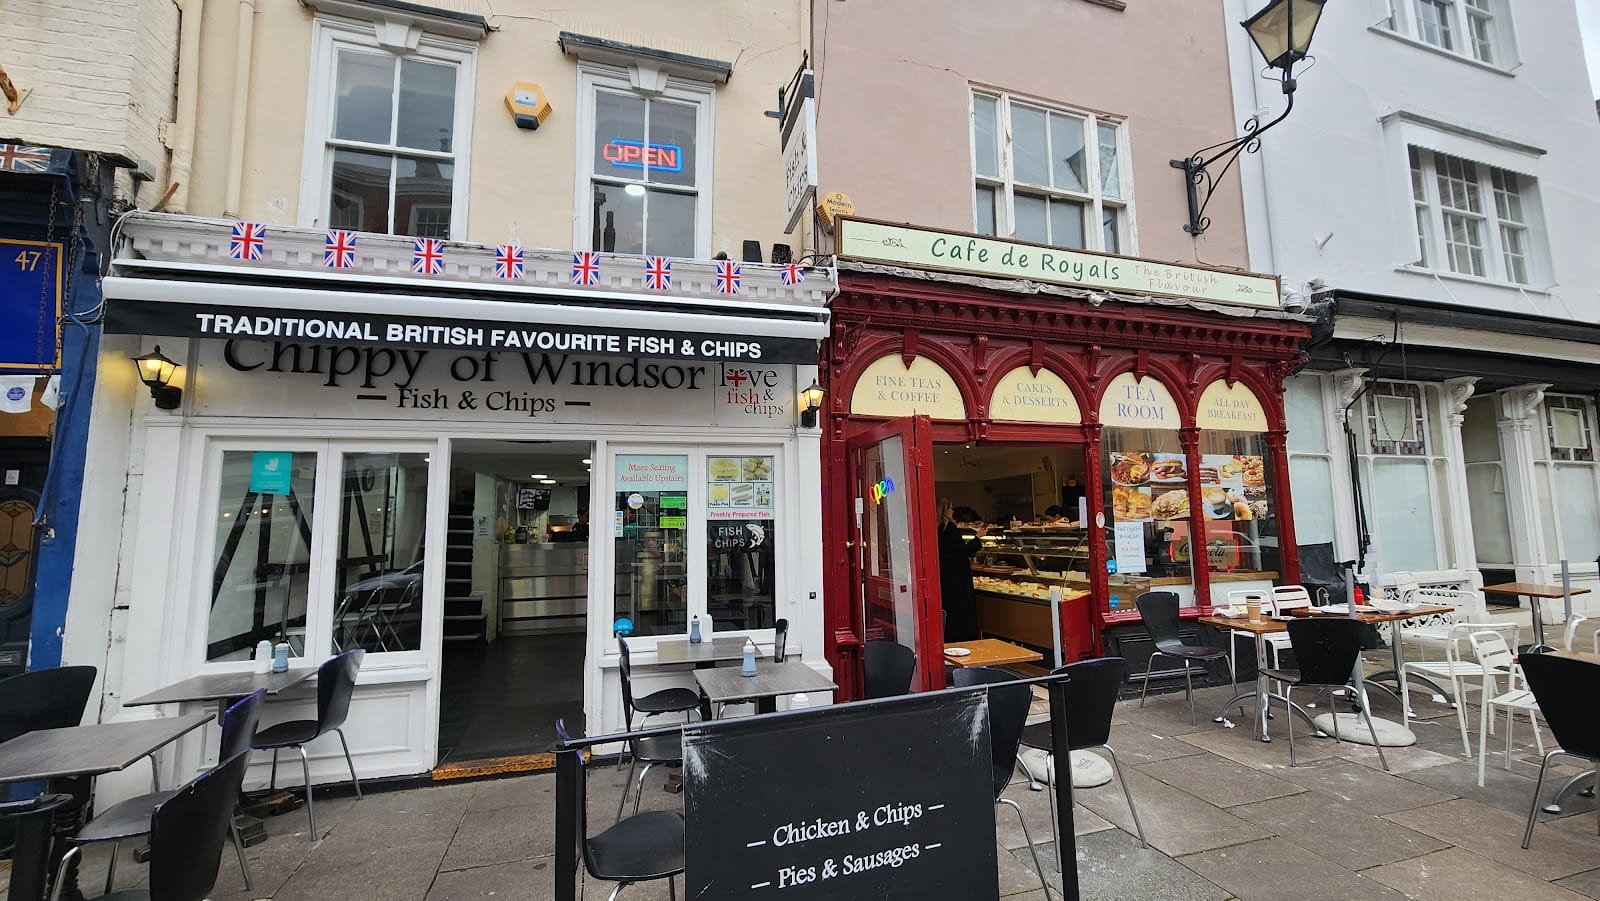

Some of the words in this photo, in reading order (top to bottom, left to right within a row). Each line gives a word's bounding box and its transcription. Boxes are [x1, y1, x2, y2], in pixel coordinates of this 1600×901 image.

[603, 142, 677, 168] OPEN
[826, 198, 852, 209] Modern
[15, 251, 43, 271] 47
[930, 238, 989, 262] Cafe
[1001, 246, 1030, 267] de
[1041, 253, 1120, 282] Royals
[1134, 264, 1162, 277] The
[1164, 269, 1220, 285] British
[1148, 278, 1208, 294] Flavour
[196, 313, 379, 341] TRADITIONAL
[386, 324, 483, 346] BRITISH
[490, 329, 620, 353] FAVOURITE
[627, 335, 674, 354] FISH
[680, 339, 696, 356] &
[700, 340, 762, 359] CHIPS
[223, 338, 429, 388] Chippy
[450, 350, 501, 382] of
[521, 351, 706, 390] Windsor
[875, 375, 906, 387] FINE
[908, 376, 942, 389] TEAS
[1016, 382, 1053, 394] CAKES
[727, 387, 759, 405] fish
[763, 388, 774, 401] &
[878, 390, 887, 401] &
[890, 390, 941, 403] COFFEE
[1002, 396, 1010, 405] &
[1013, 395, 1069, 408] DESSERTS
[1122, 384, 1157, 402] TEA
[396, 387, 449, 410] Fish
[457, 390, 478, 410] &
[485, 390, 556, 418] Chips
[744, 400, 785, 418] chips
[1214, 398, 1230, 408] ALL
[1233, 400, 1251, 410] DAY
[1116, 403, 1165, 421] ROOM
[1207, 409, 1258, 422] BREAKFAST
[628, 463, 649, 471] More
[650, 463, 677, 473] Seating
[620, 474, 653, 482] Available
[655, 474, 684, 484] Upstairs
[710, 511, 731, 519] Freshly
[732, 511, 758, 519] Prepared
[718, 526, 743, 537] FISH
[714, 539, 746, 550] CHIPS
[772, 817, 851, 848] Chicken
[855, 811, 870, 832] &
[873, 802, 923, 826] Chips
[777, 865, 817, 889] Pies
[821, 859, 839, 880] &
[842, 842, 920, 876] Sausages
